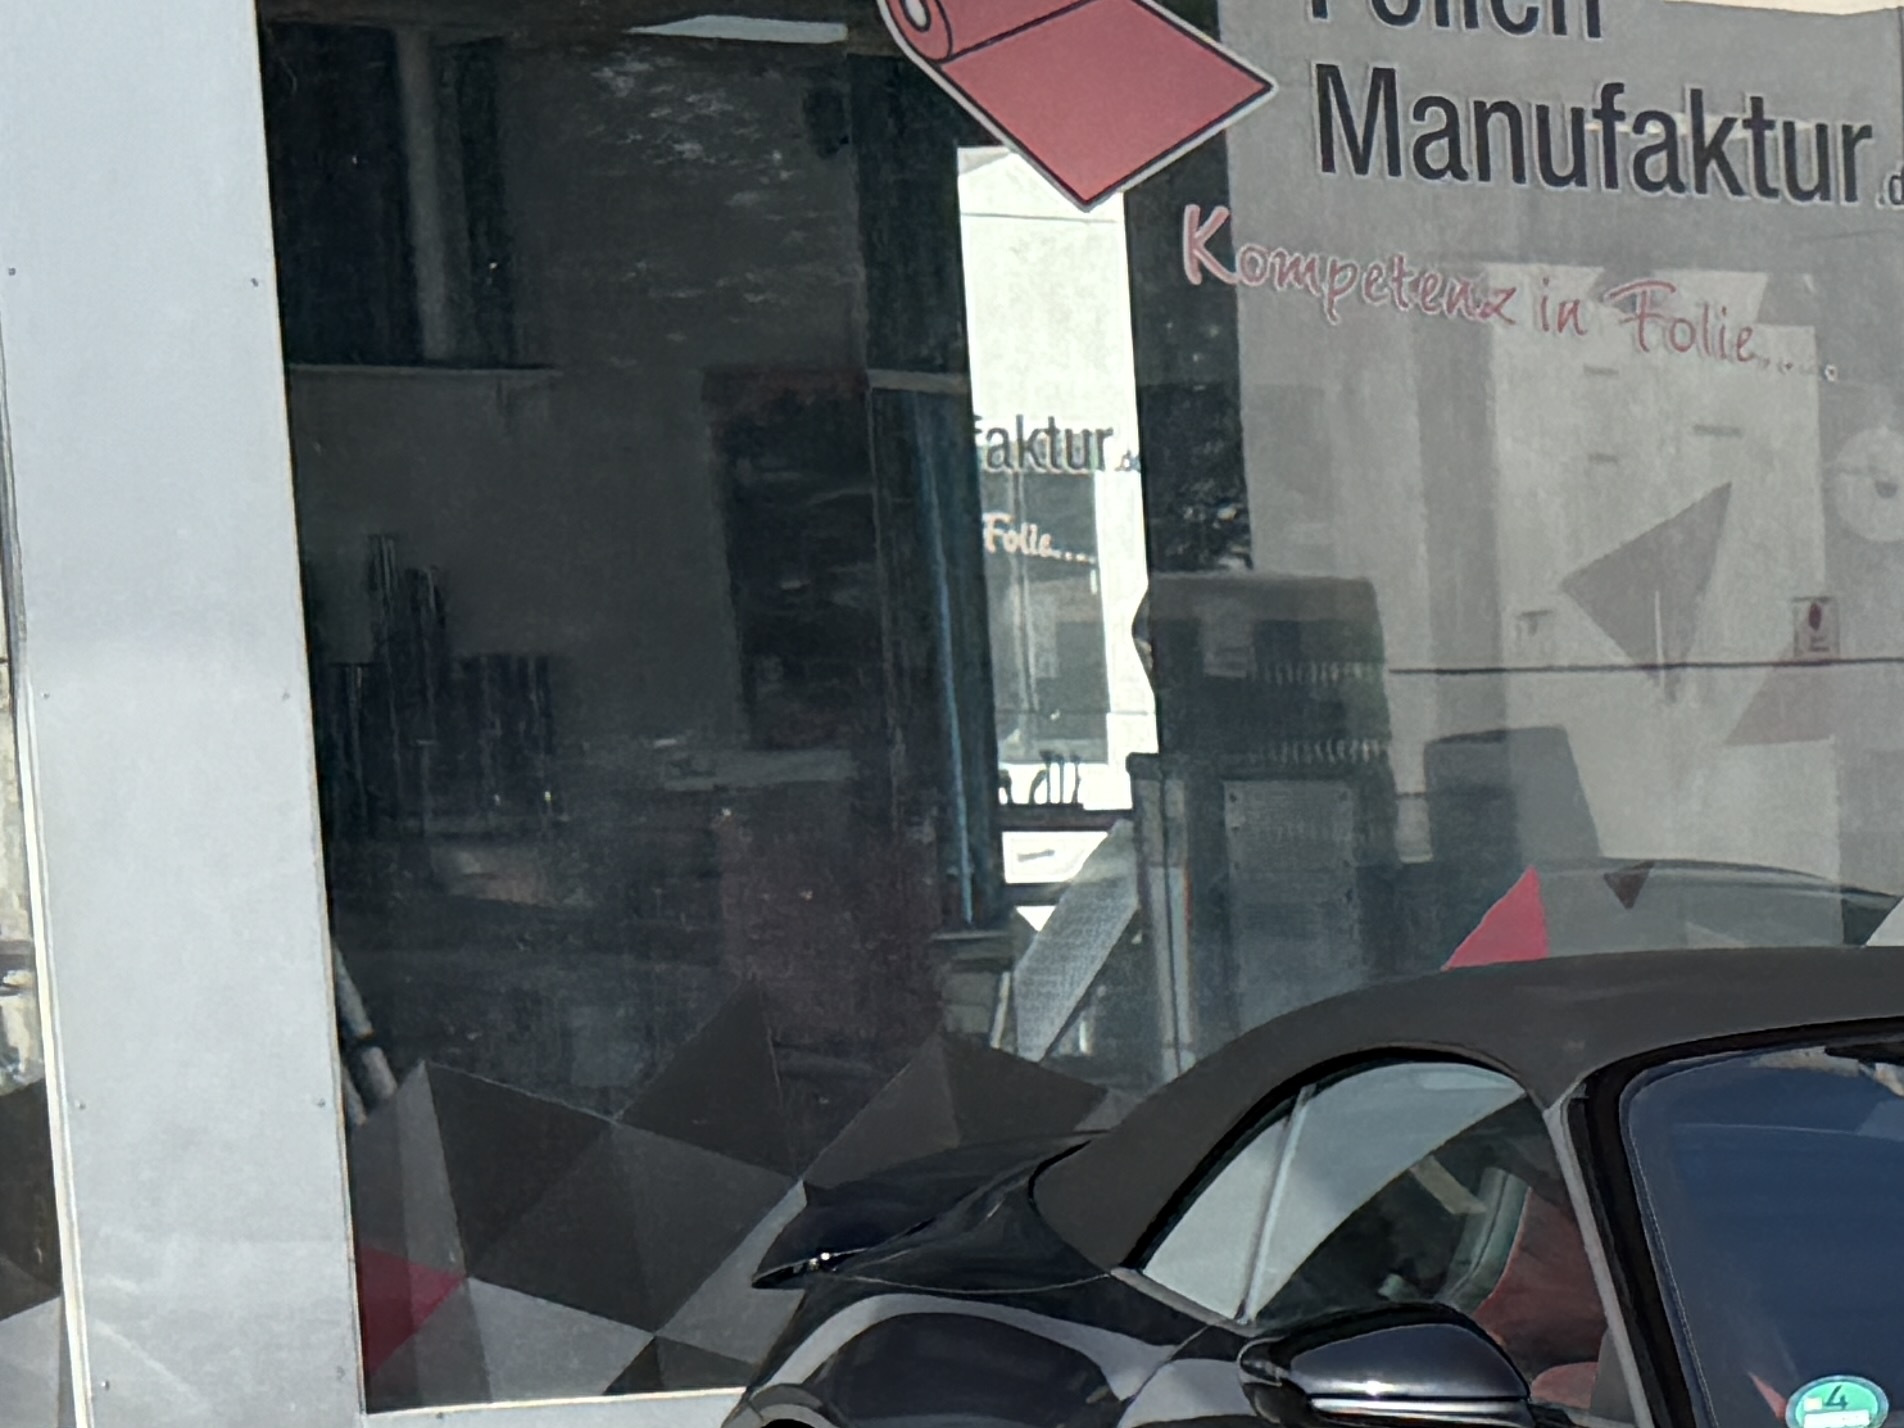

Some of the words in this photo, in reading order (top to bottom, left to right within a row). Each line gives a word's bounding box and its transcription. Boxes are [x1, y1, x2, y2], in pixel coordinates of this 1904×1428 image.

[1183, 203, 1518, 327] Kompetenz
[1538, 276, 1588, 337] in
[1824, 1384, 1850, 1411] 4
